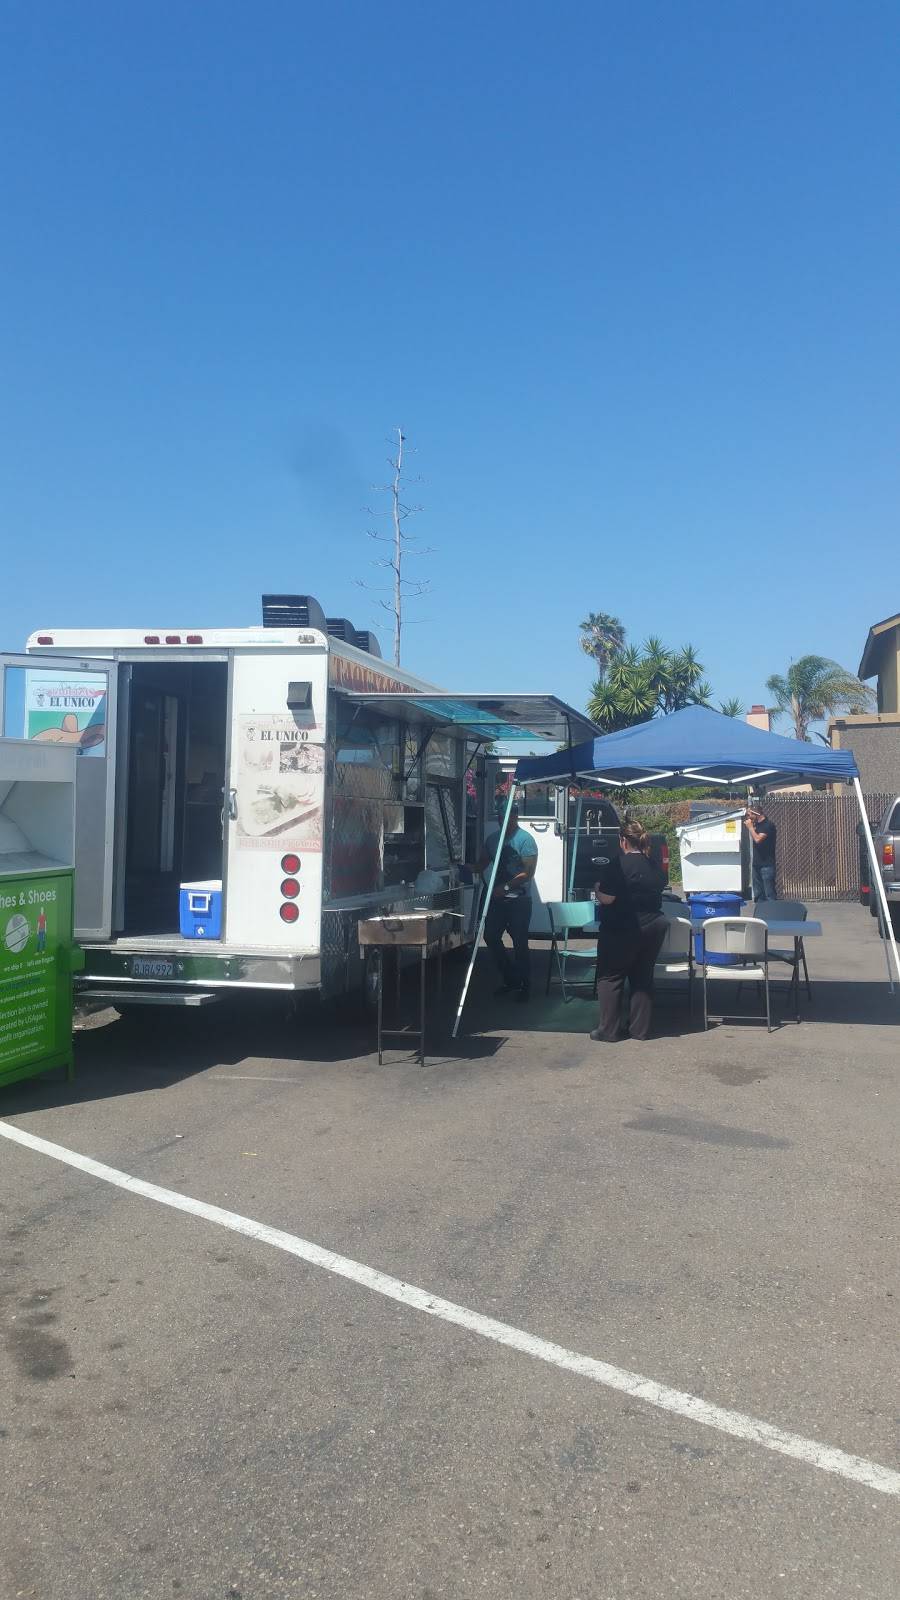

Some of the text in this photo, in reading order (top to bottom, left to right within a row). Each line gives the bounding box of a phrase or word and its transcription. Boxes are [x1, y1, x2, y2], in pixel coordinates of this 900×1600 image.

[50, 697, 95, 708] EL UNICO
[260, 730, 309, 741] EL UNICO
[19, 891, 26, 906] &
[28, 889, 57, 904] Shoes
